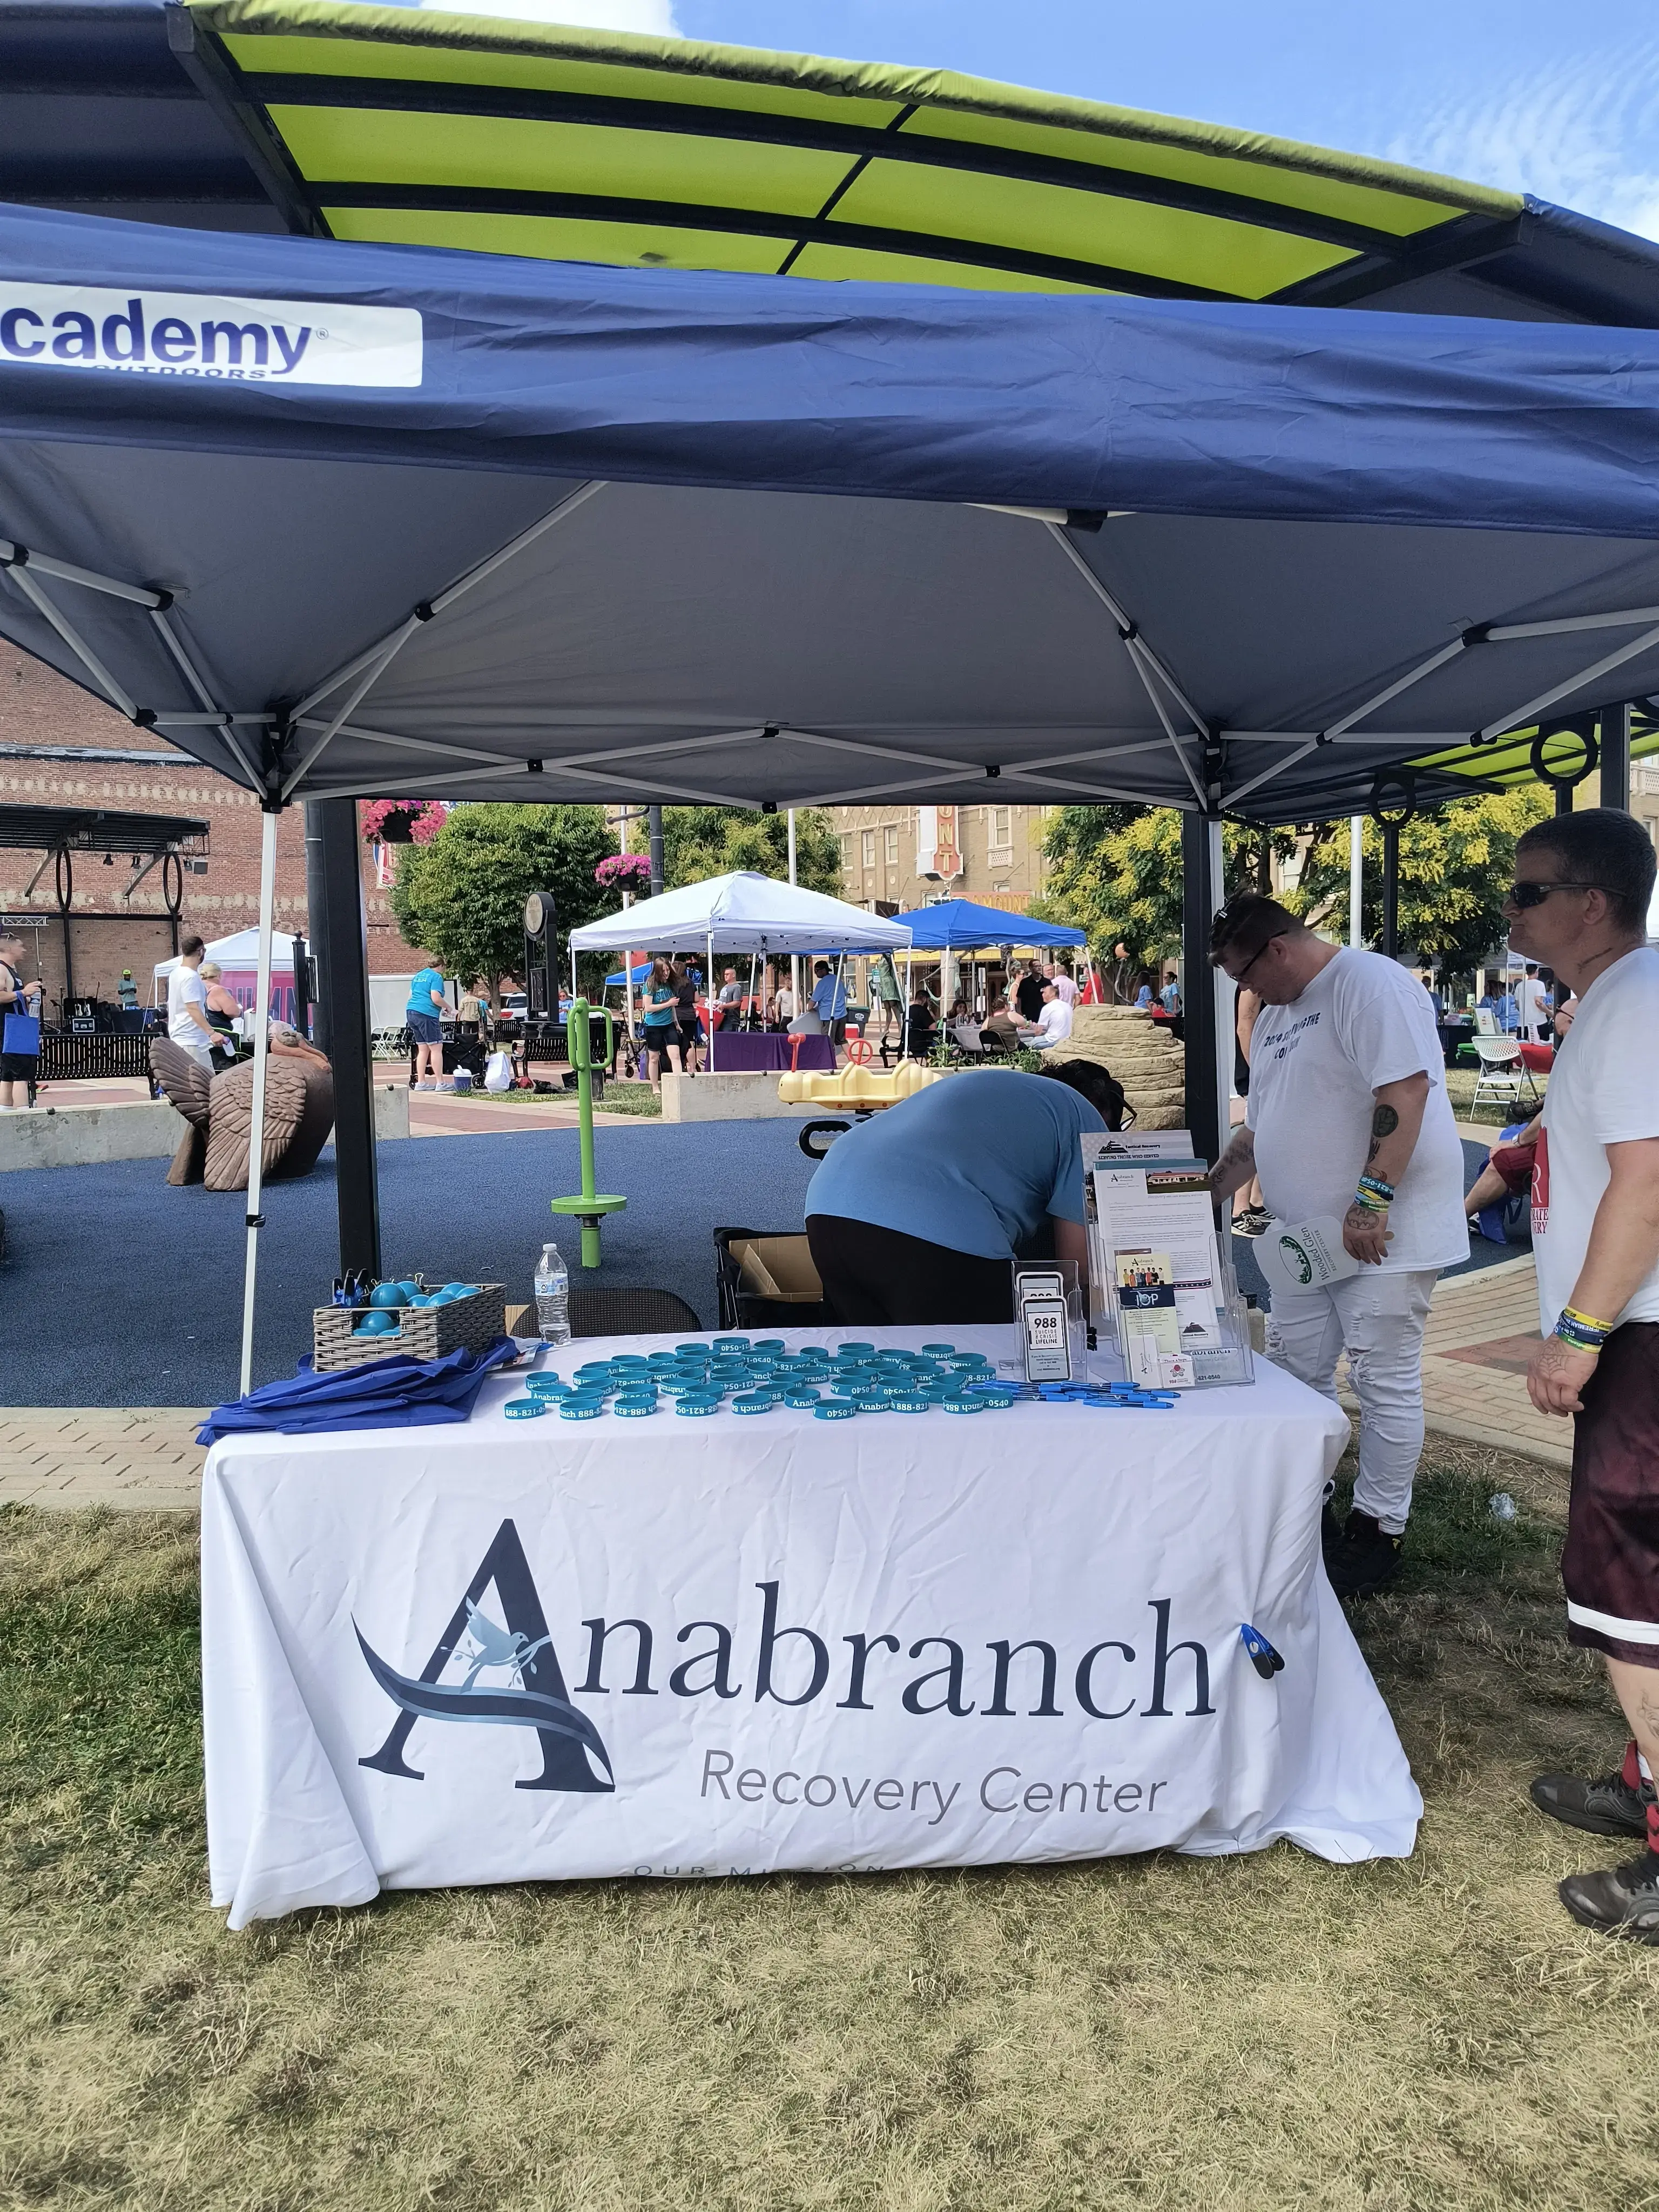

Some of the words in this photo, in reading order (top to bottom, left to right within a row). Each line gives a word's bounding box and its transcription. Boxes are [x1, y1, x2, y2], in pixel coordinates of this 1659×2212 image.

[1301, 1227, 1314, 1248] Glen
[1314, 1229, 1326, 1248] CENTER
[1307, 1248, 1330, 1280] Wooded
[1323, 1249, 1337, 1272] RECOVERY
[1034, 1317, 1057, 1328] 988
[351, 1518, 1216, 1792] Anabranch
[700, 1749, 961, 1826] Recovery
[979, 1766, 1168, 1813] Center
[634, 1865, 707, 1876] OUR
